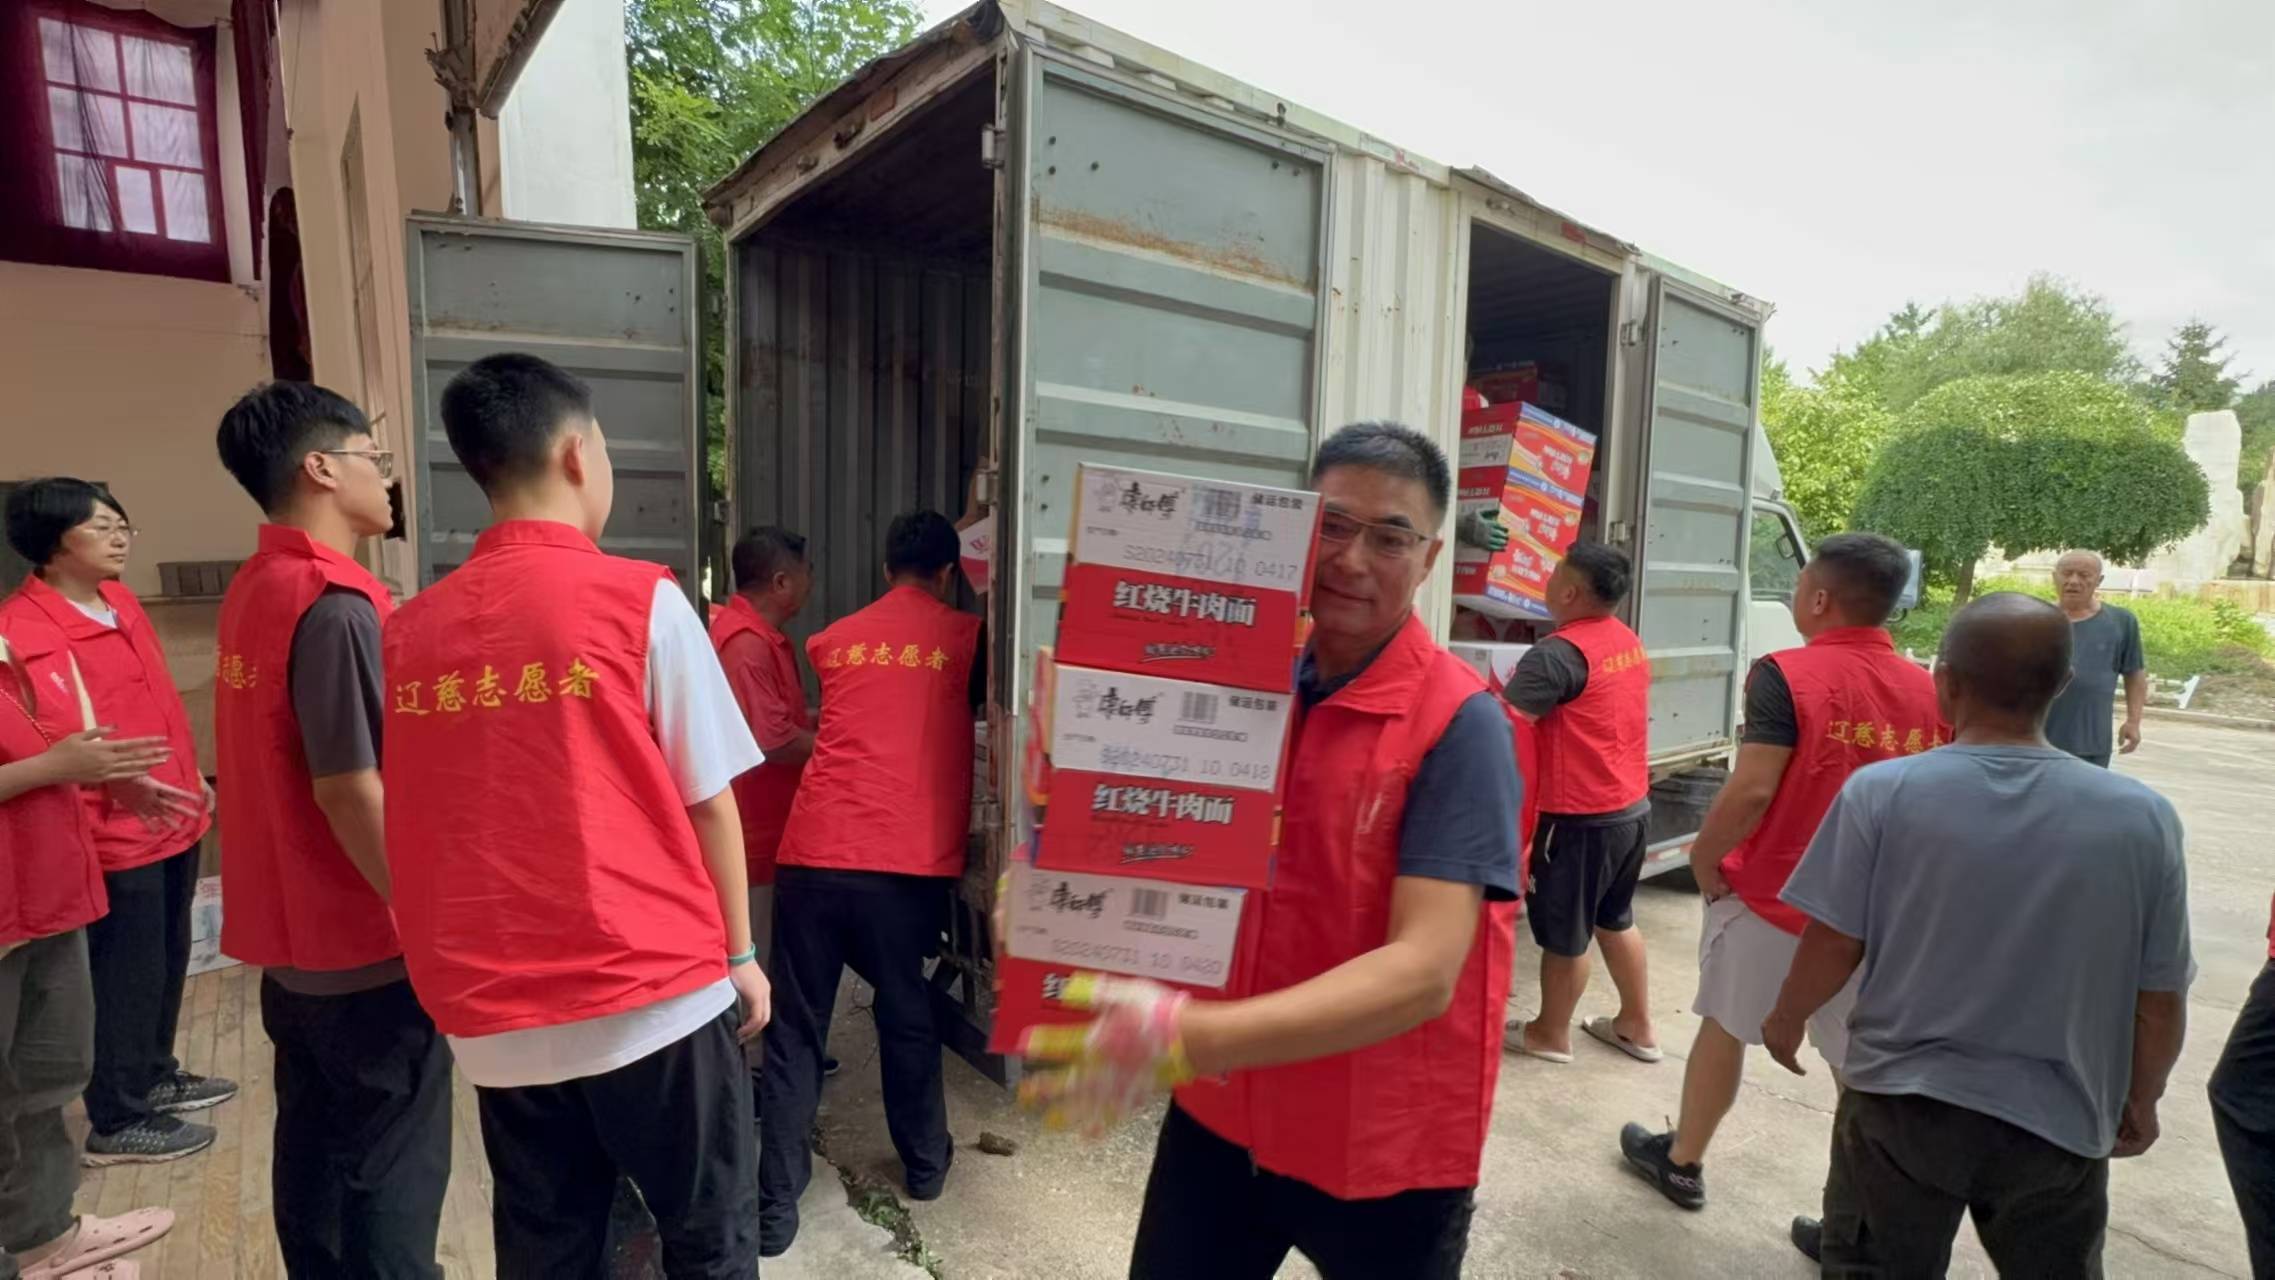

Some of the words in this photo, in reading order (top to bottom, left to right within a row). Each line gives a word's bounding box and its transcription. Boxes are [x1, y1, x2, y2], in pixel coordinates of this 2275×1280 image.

[1113, 580, 1257, 627] 红烧牛肉面
[827, 641, 949, 672] 辽慈志愿者
[394, 657, 600, 716] 辽慈志愿者
[1092, 783, 1235, 825] 红烧牛肉面
